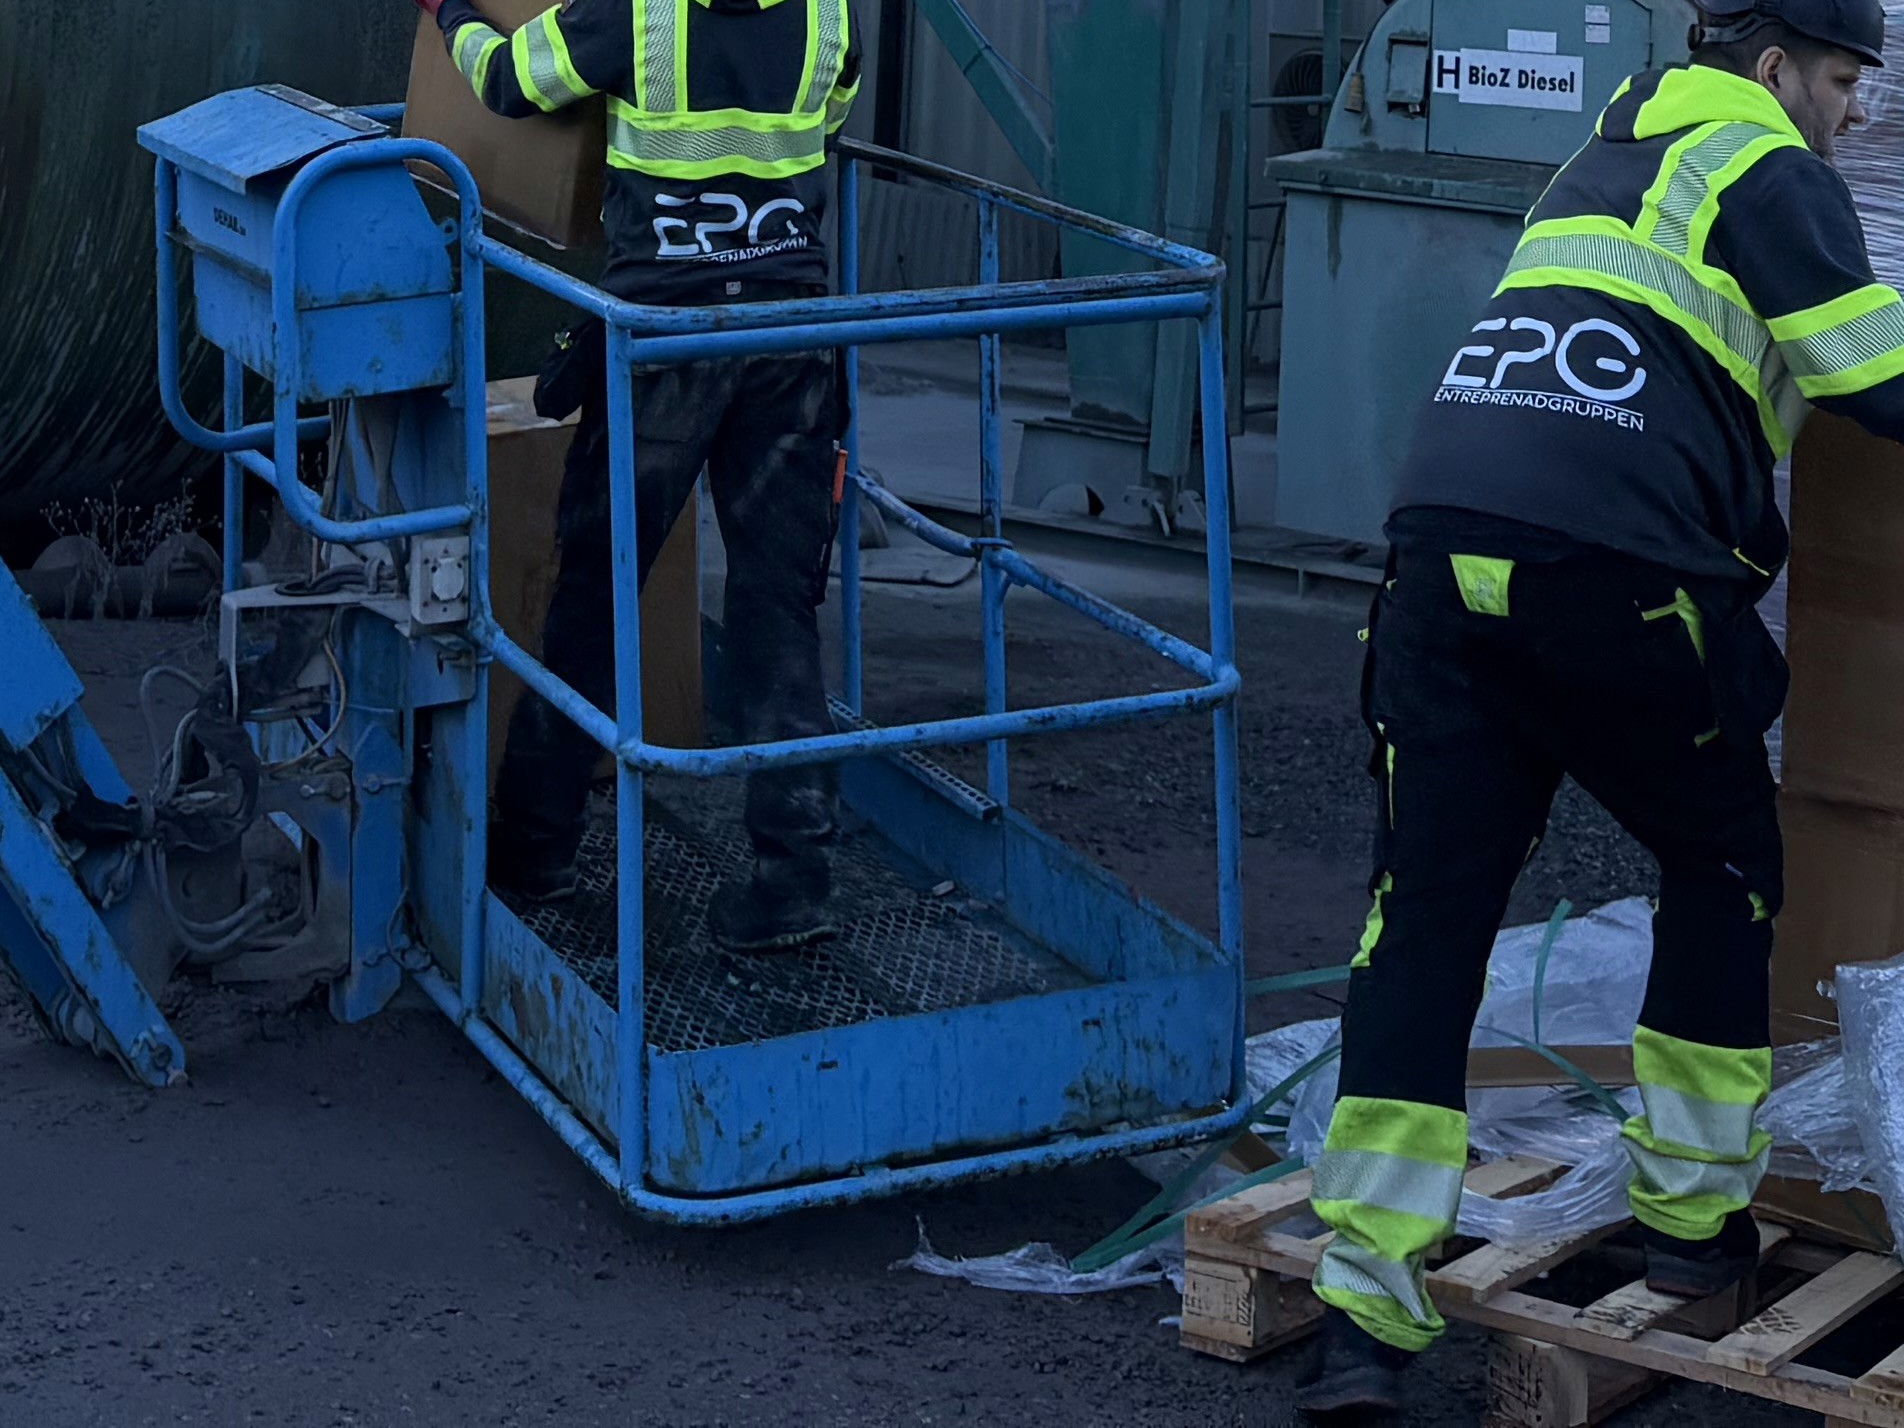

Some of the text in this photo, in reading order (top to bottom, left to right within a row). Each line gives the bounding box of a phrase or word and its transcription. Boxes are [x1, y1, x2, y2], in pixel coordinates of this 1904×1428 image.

[1437, 54, 1575, 93] H BioZ Diesel
[1442, 316, 1647, 402] EPG
[1433, 386, 1645, 432] ENTREPRENADGRUPPEN
